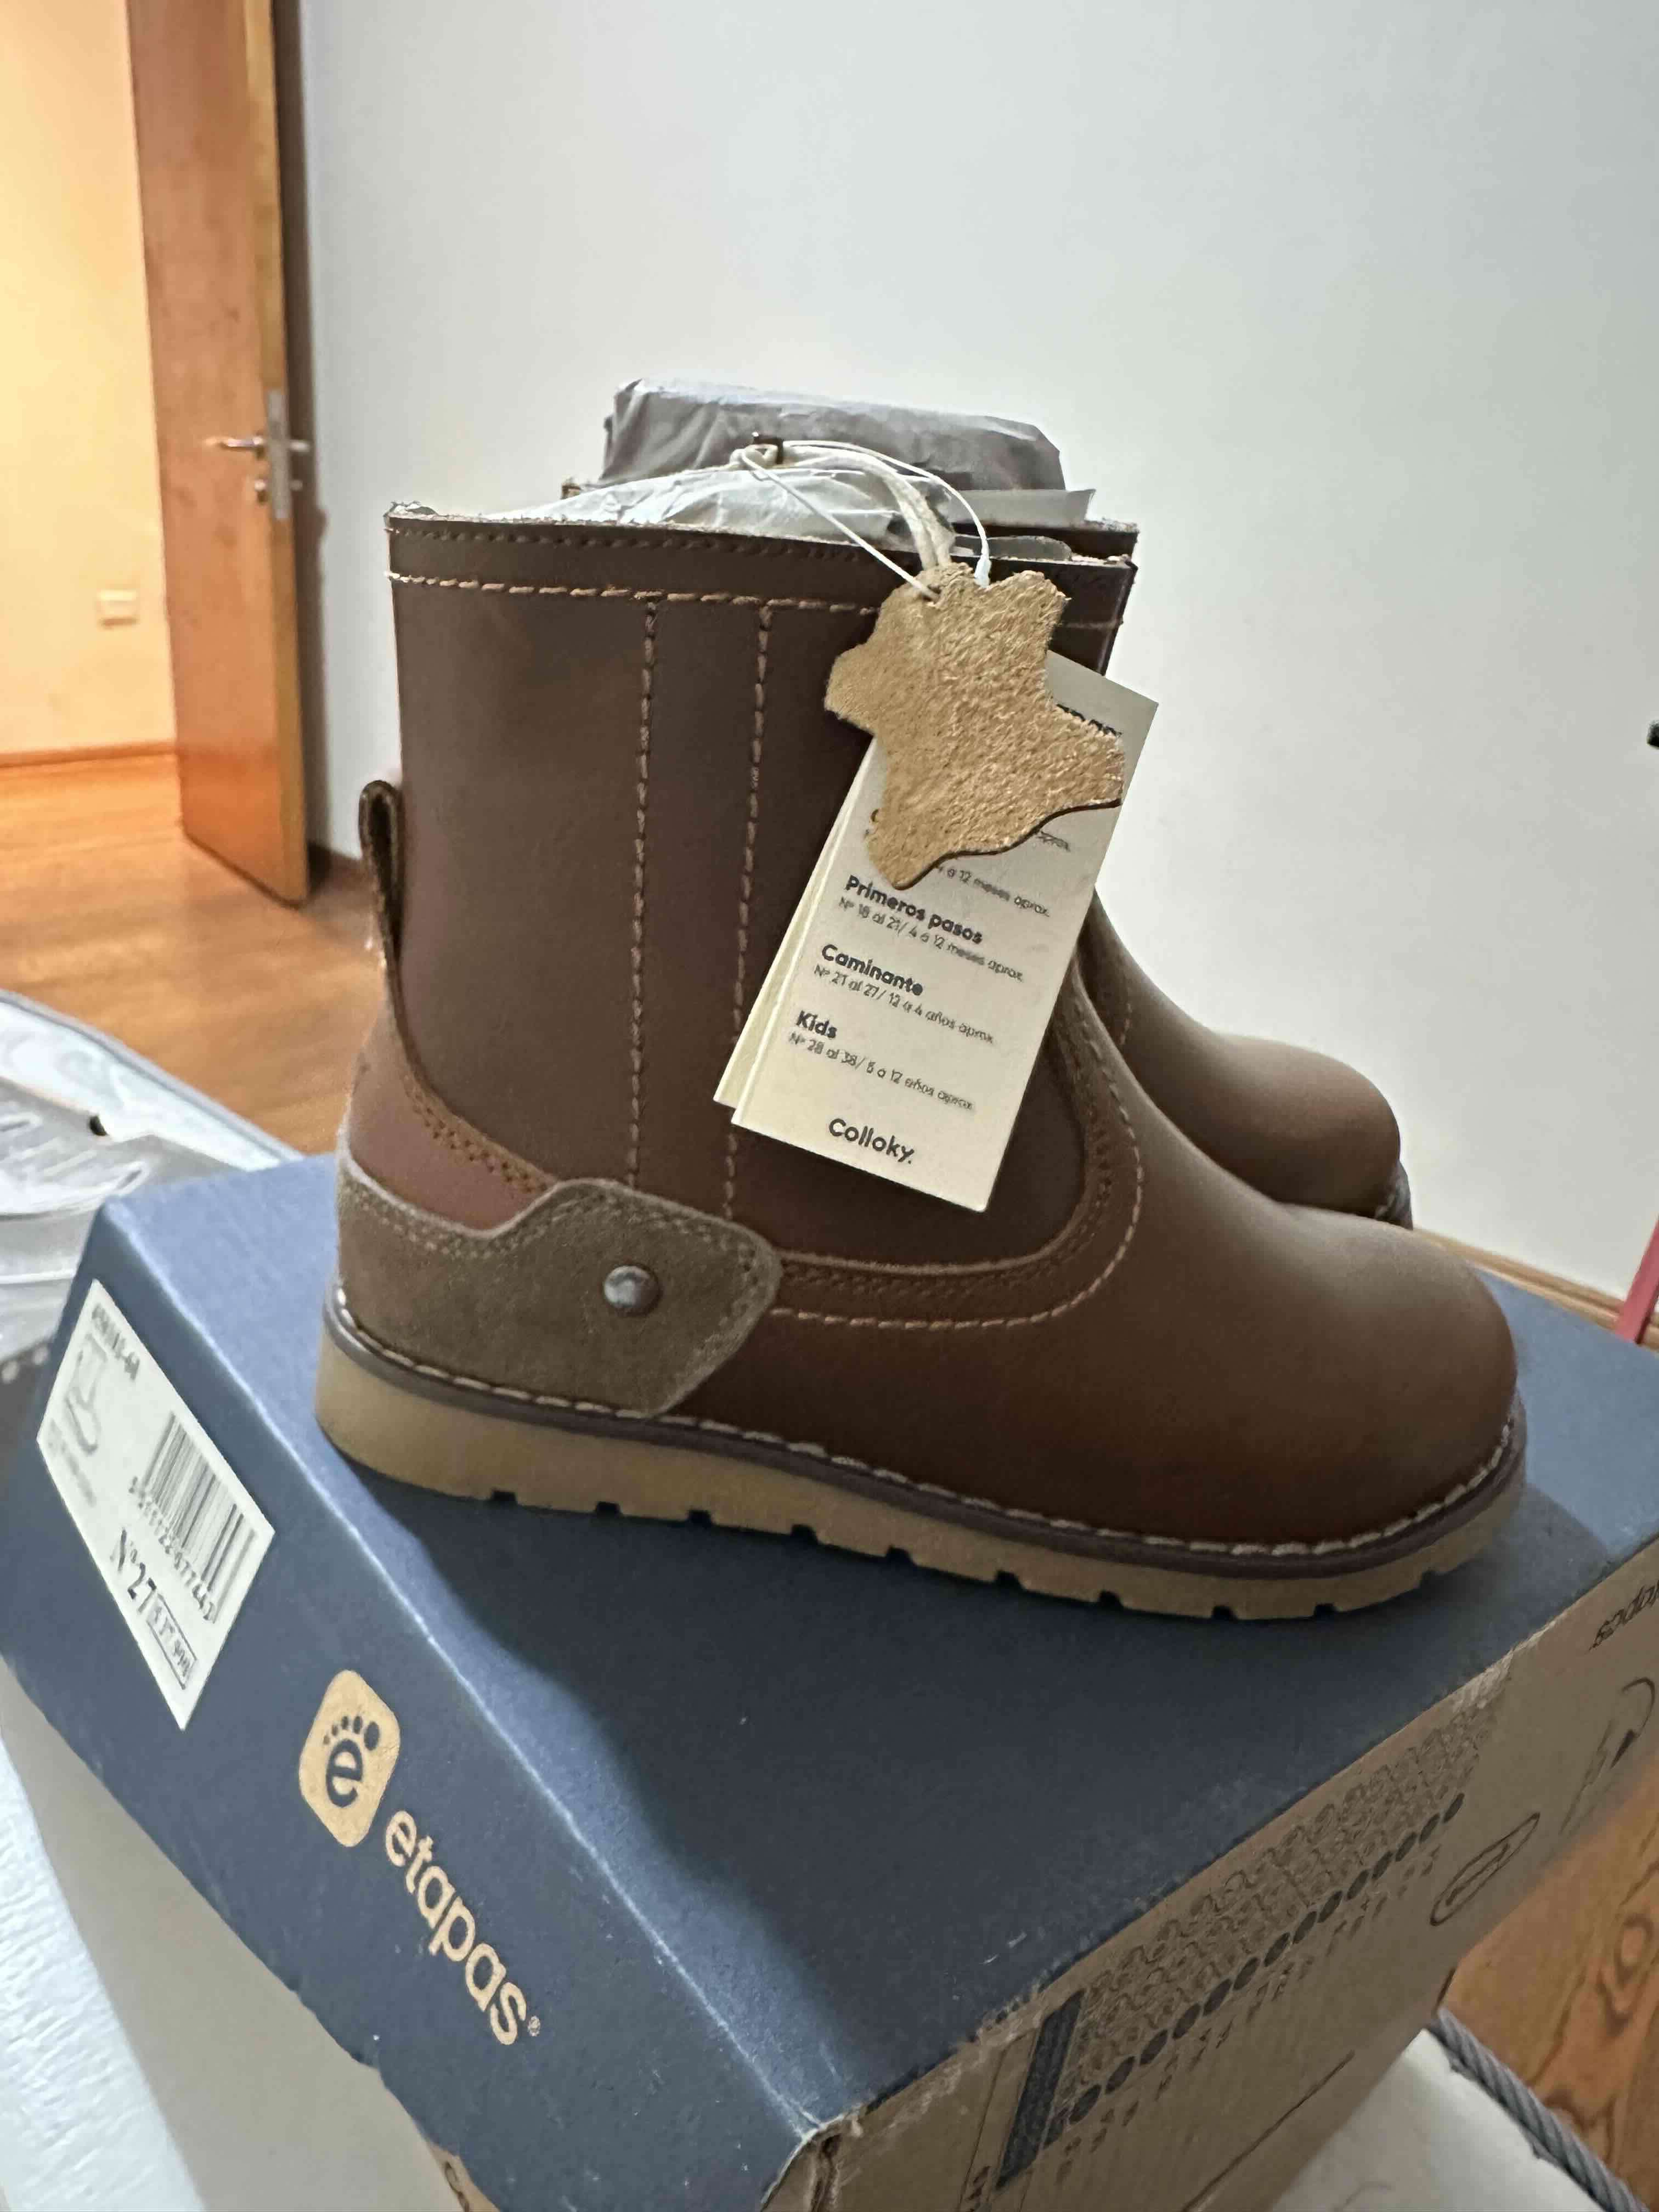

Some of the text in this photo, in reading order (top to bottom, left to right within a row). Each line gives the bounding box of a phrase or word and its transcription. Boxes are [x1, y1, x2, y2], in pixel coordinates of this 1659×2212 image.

[845, 874, 983, 944] Primeros pasos
[821, 943, 924, 996] Caminante
[795, 1009, 838, 1040] Kids
[828, 1117, 915, 1165] Colloky.
